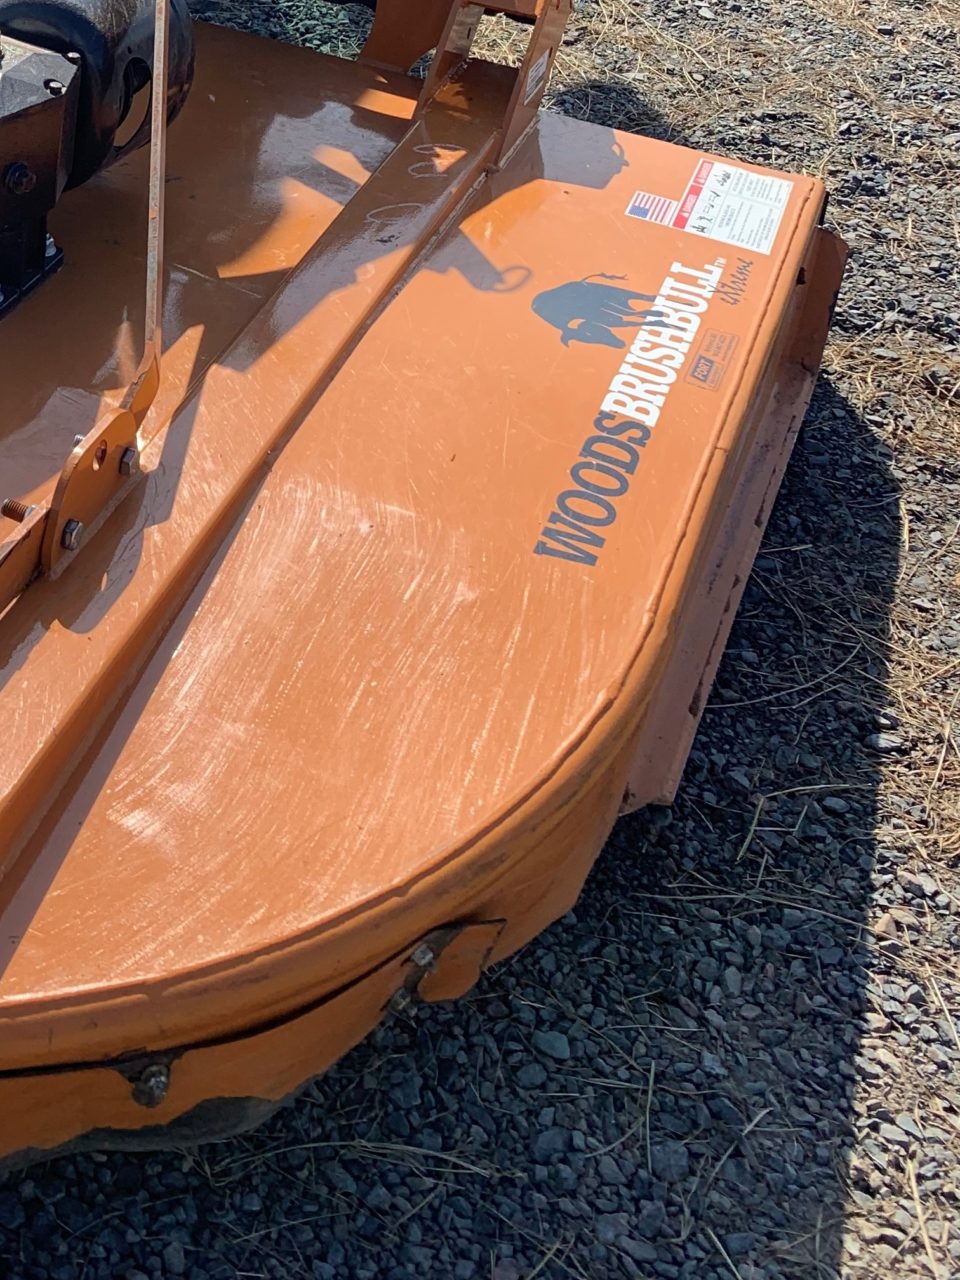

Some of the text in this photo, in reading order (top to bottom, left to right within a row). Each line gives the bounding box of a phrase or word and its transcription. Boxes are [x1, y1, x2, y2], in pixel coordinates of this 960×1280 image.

[533, 409, 652, 567] WOODS
[600, 261, 724, 428] BRUSHBULL
[692, 356, 714, 381] FORT
